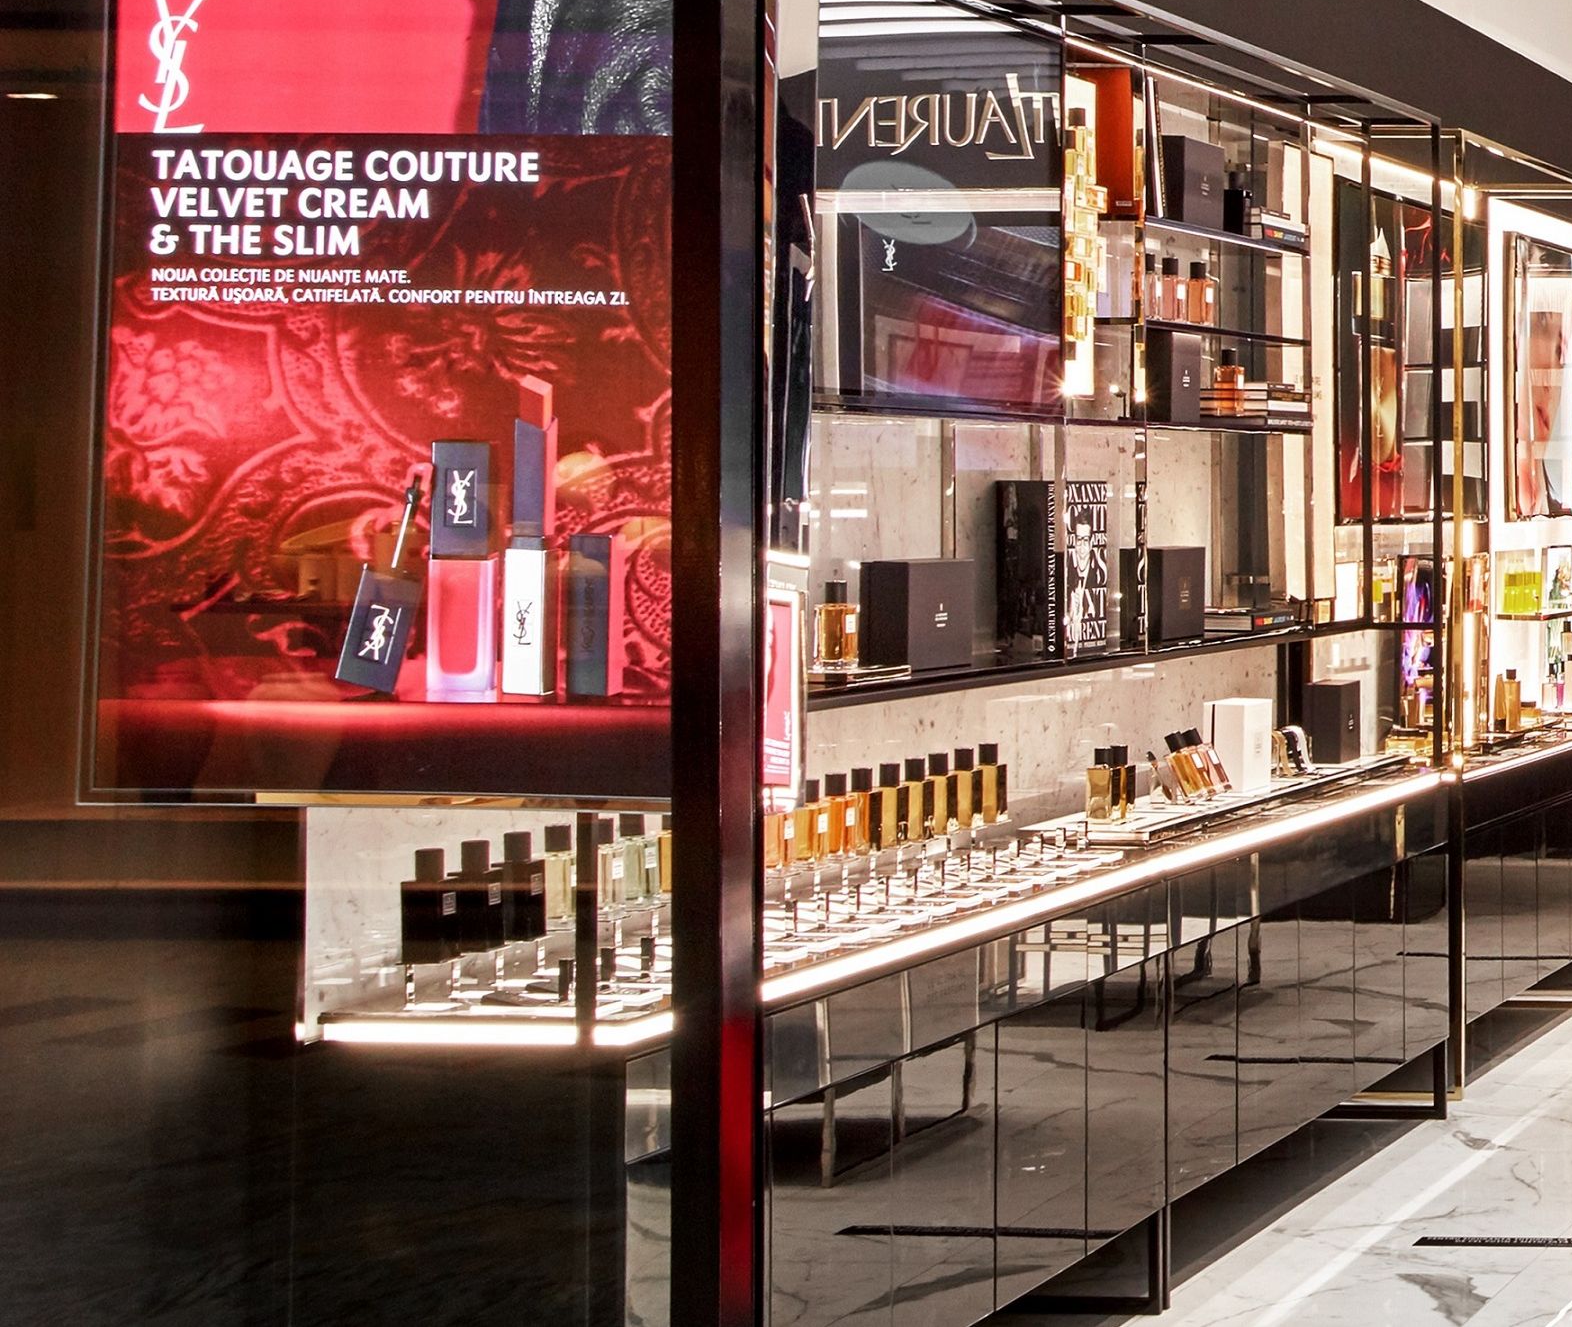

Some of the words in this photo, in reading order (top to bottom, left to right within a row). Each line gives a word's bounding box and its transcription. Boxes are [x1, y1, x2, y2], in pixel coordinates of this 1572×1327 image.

[151, 148, 354, 182] TATOUAGE
[364, 149, 540, 183] COUTURE
[150, 186, 289, 219] VELVET
[297, 187, 430, 220] CREAM
[149, 223, 179, 255] &
[188, 224, 262, 255] THE
[272, 224, 360, 257] SLIM
[151, 267, 197, 283] NOUA
[274, 268, 295, 283] DE
[364, 269, 412, 285] MATE.
[388, 289, 462, 304] CONFORT
[465, 290, 525, 305] PENTRU
[528, 288, 607, 305] ÎNTREAGA
[609, 291, 630, 306] ZI.
